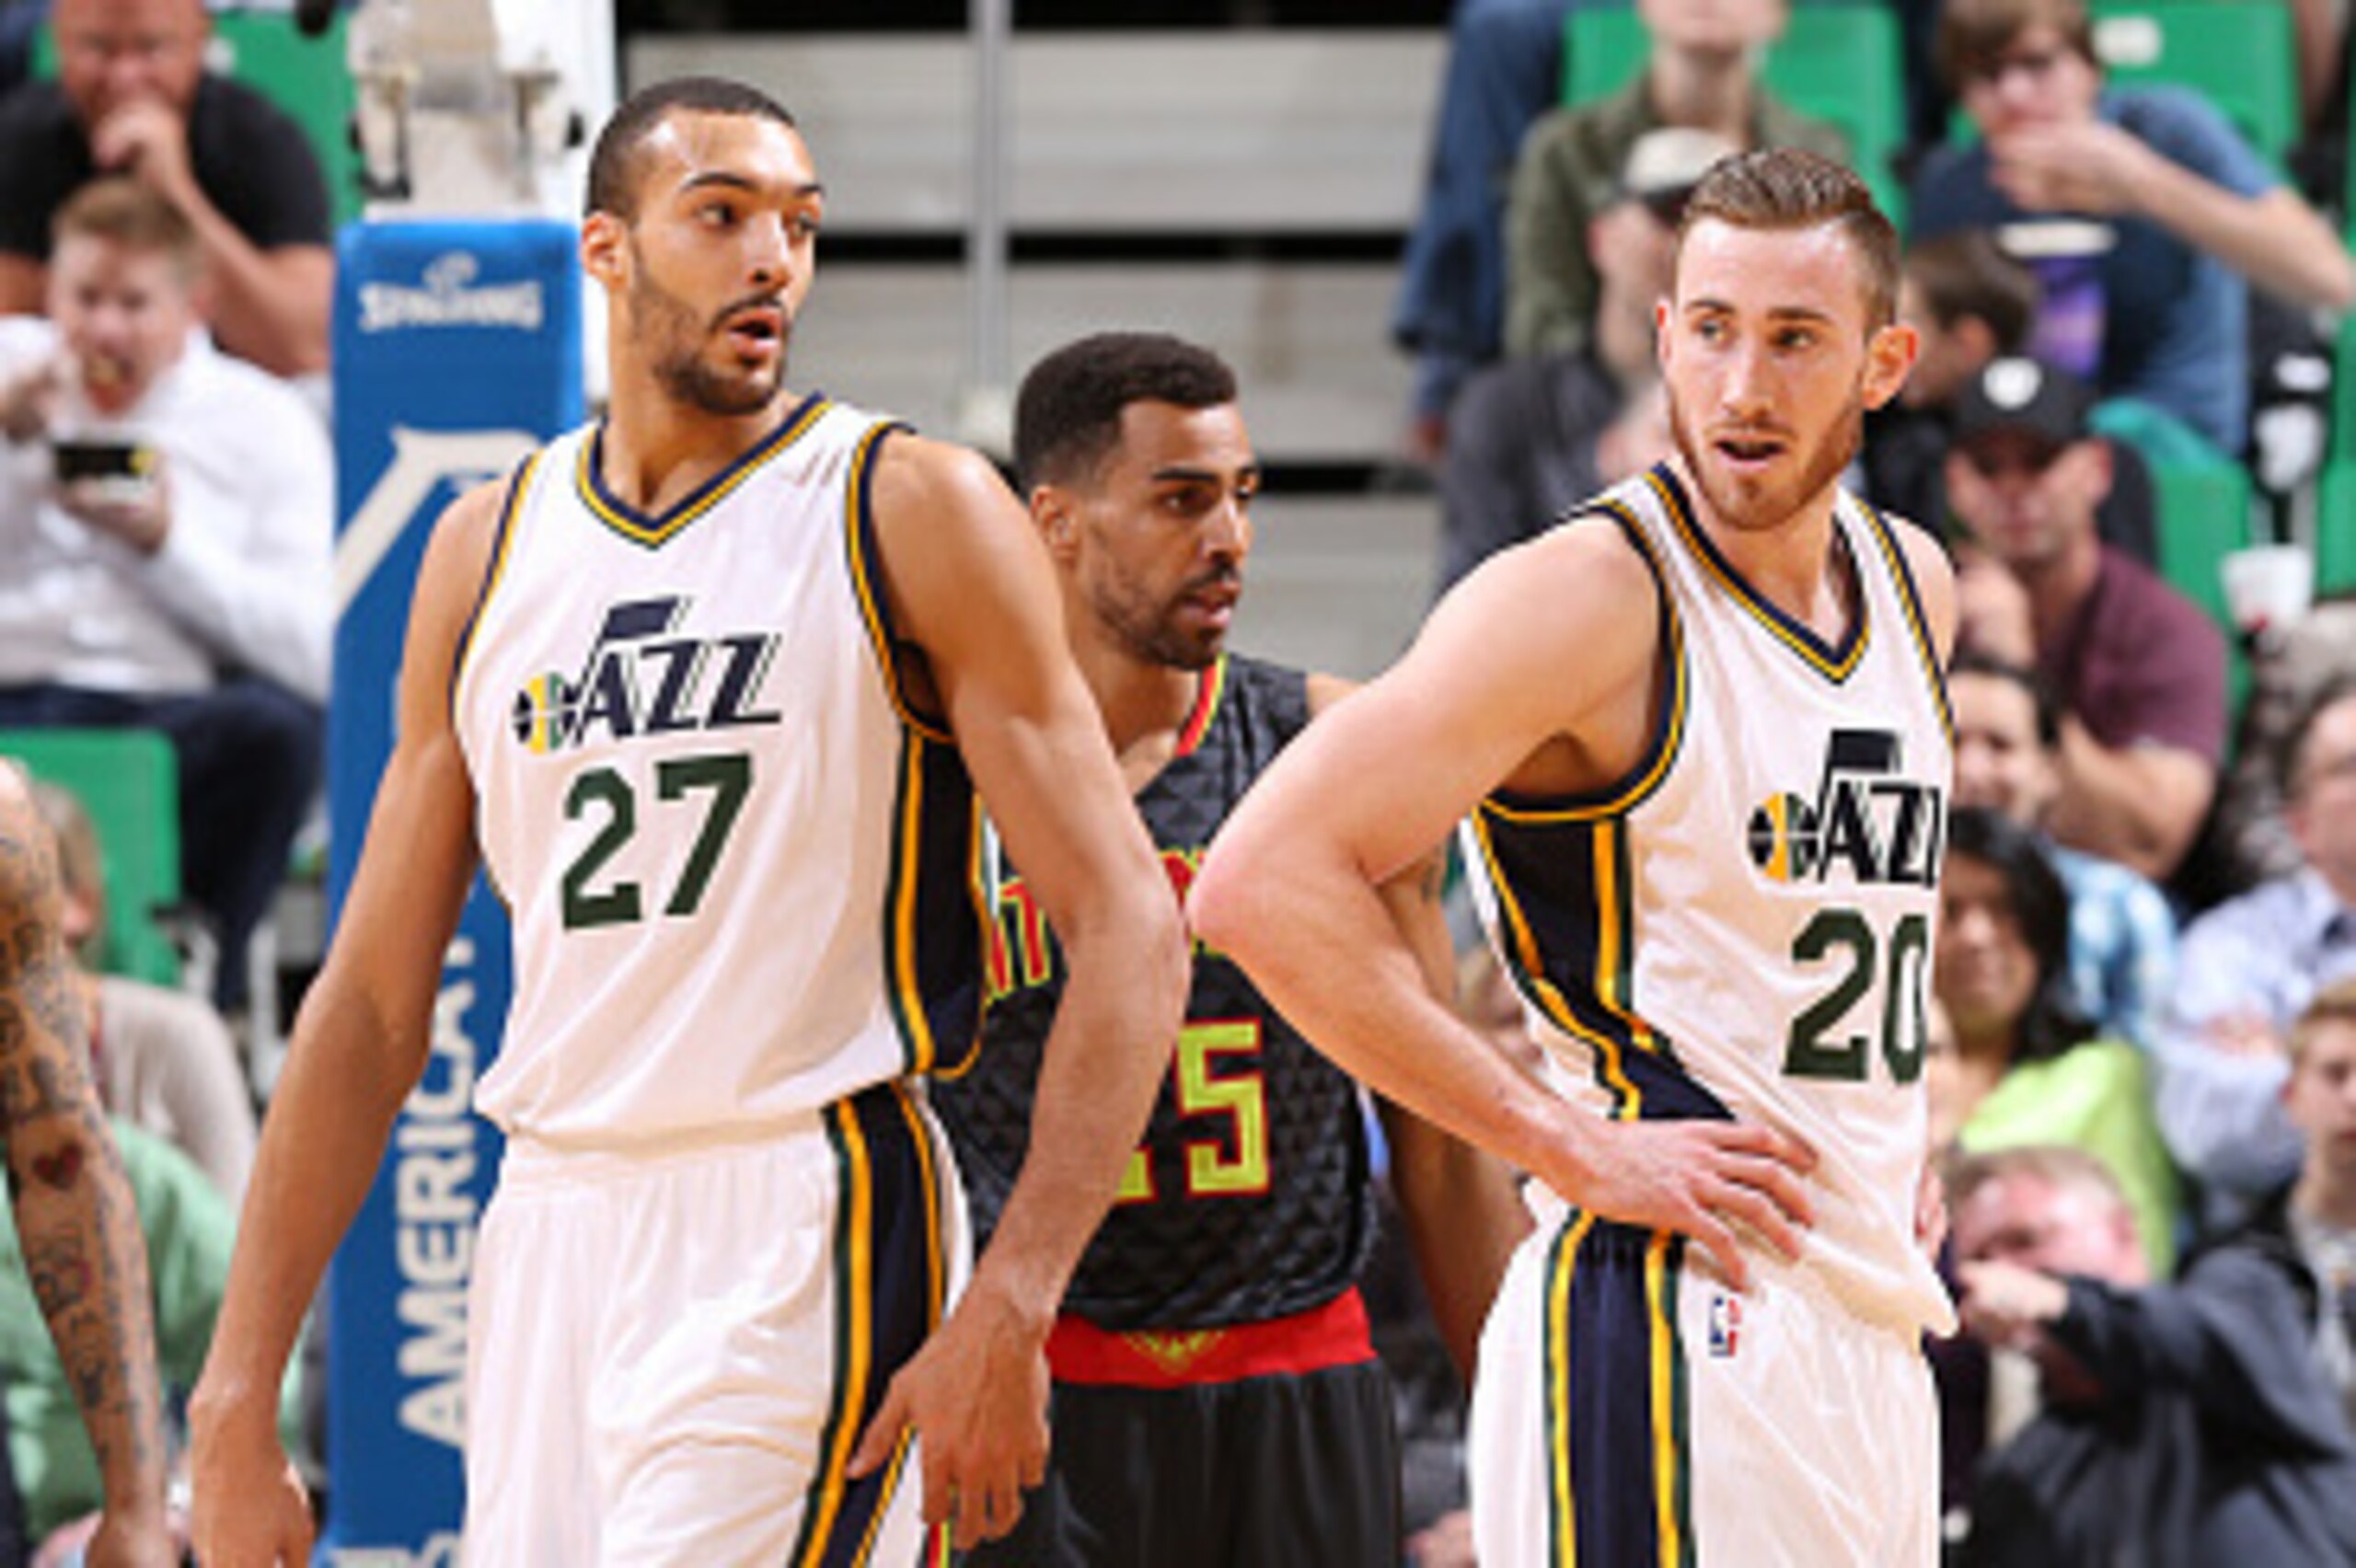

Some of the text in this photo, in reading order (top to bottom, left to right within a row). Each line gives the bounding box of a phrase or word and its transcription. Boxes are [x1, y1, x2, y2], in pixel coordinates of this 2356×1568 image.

[514, 595, 785, 756] JAZZ
[560, 749, 752, 932] 27
[1780, 907, 1929, 1084] 20
[1111, 1018, 1270, 1204] 5
